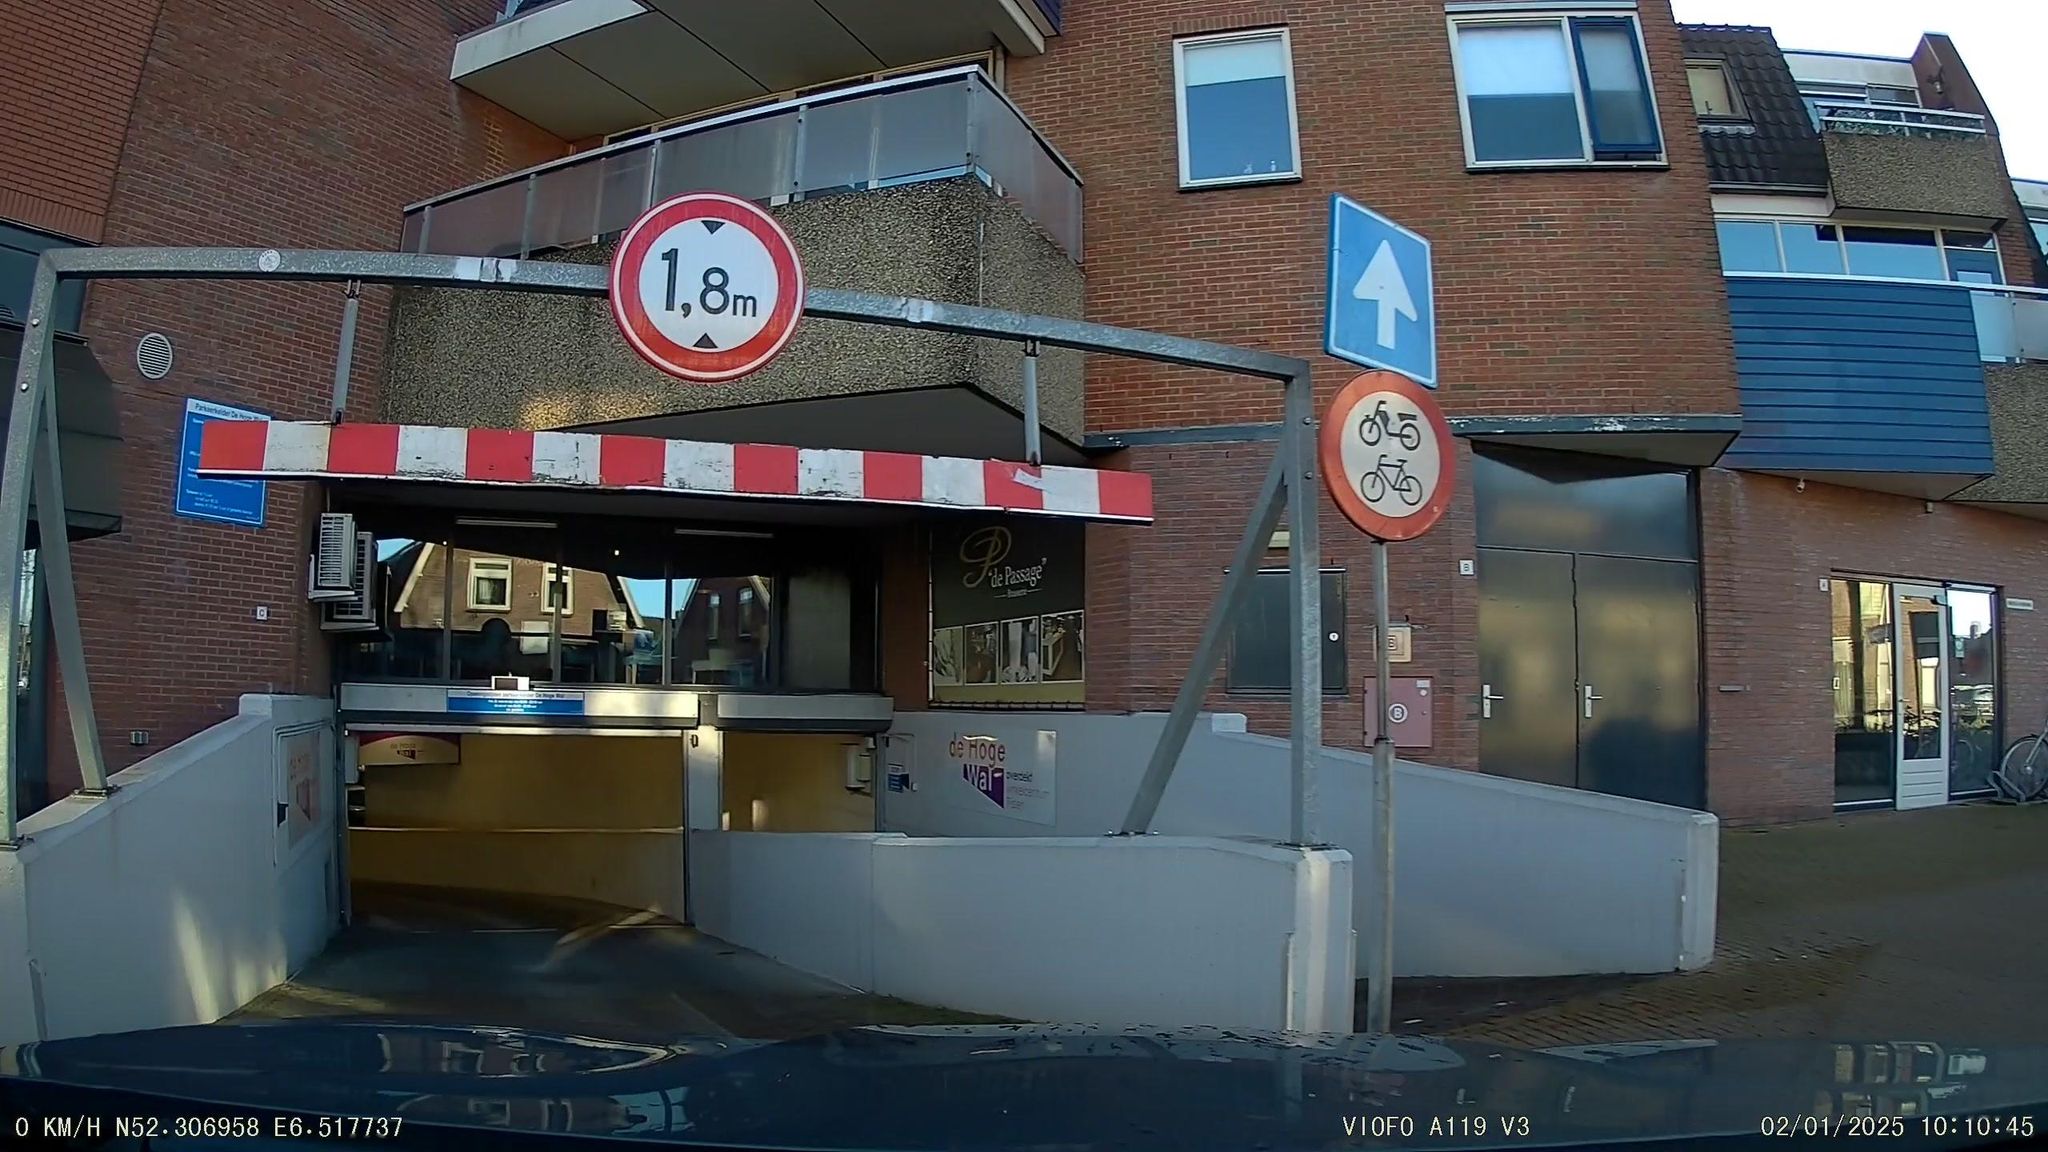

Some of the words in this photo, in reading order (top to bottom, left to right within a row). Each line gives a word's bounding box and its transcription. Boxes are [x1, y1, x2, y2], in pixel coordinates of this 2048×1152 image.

[661, 248, 757, 319] 1,8m
[1394, 708, 1402, 719] B
[949, 732, 963, 758] de
[969, 737, 1005, 768] Hoge
